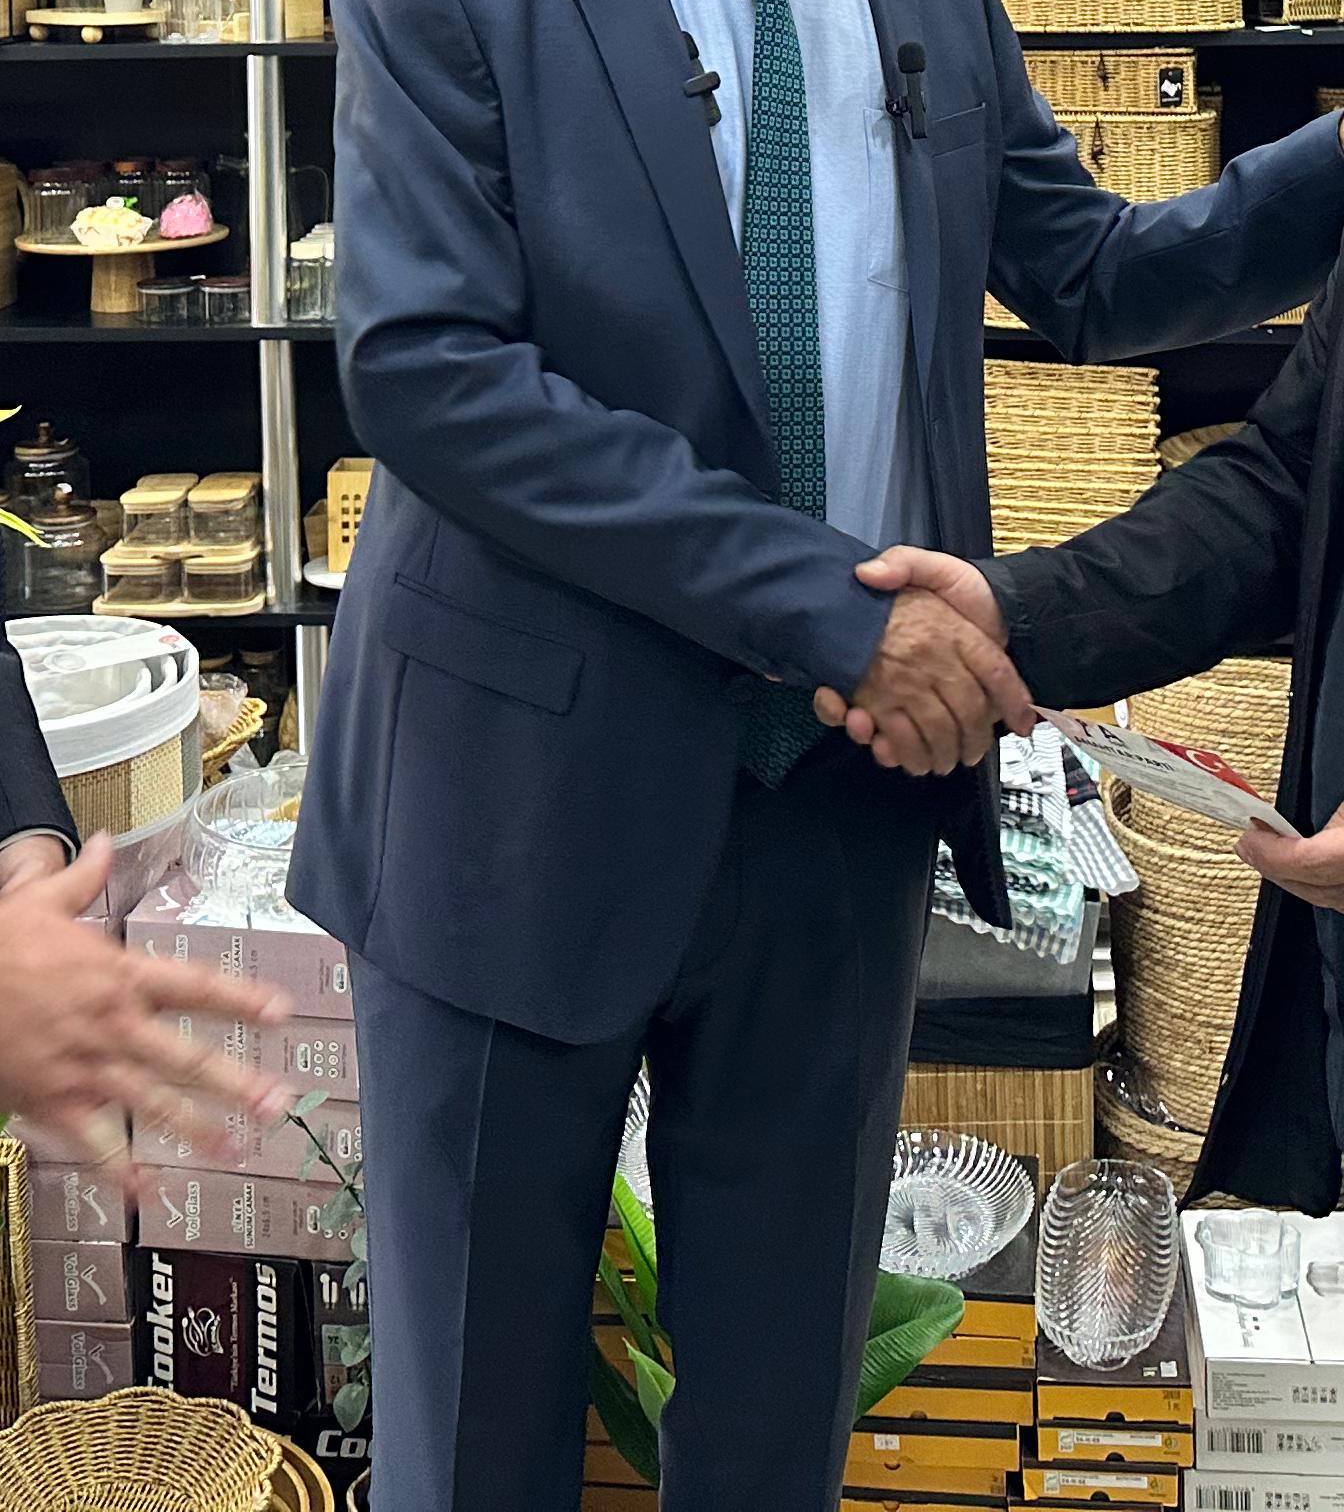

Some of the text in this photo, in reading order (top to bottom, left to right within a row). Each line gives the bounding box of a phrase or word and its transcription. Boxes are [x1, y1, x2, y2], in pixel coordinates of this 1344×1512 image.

[188, 1183, 199, 1218] Glass
[245, 1184, 255, 1214] ÇANAK
[66, 1277, 78, 1311] Glass
[252, 1262, 277, 1414] Termos
